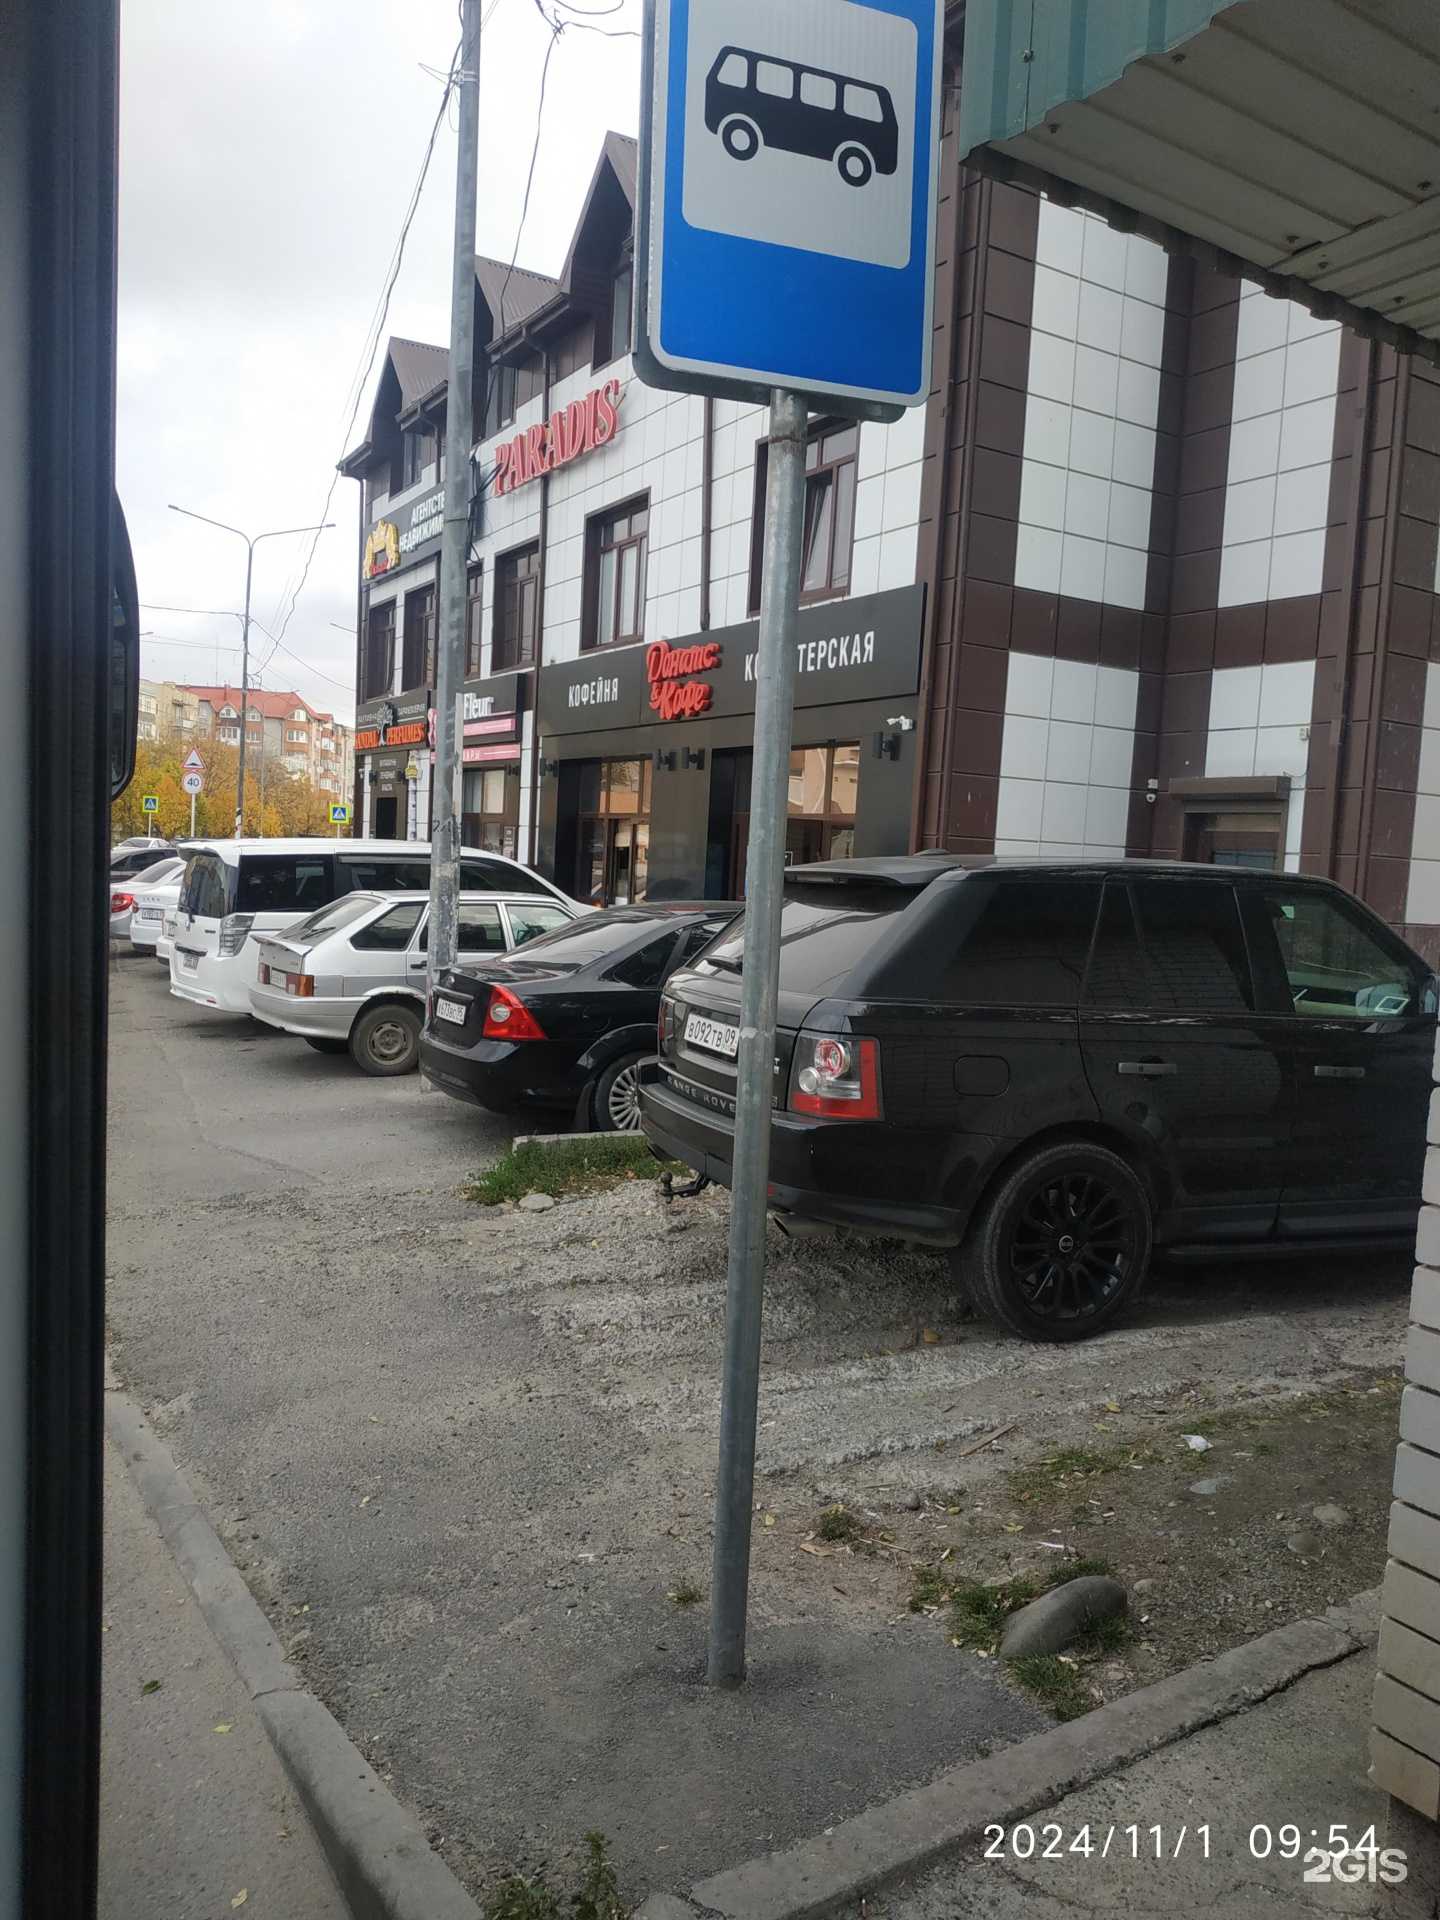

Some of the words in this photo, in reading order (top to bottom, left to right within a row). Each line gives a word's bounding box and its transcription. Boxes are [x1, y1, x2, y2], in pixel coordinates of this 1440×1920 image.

[492, 378, 620, 496] PARADIS
[464, 692, 495, 720] Fleur
[568, 677, 619, 708] КОФЕЙНЯ
[187, 777, 199, 787] 40
[703, 1093, 736, 1113] ROVE
